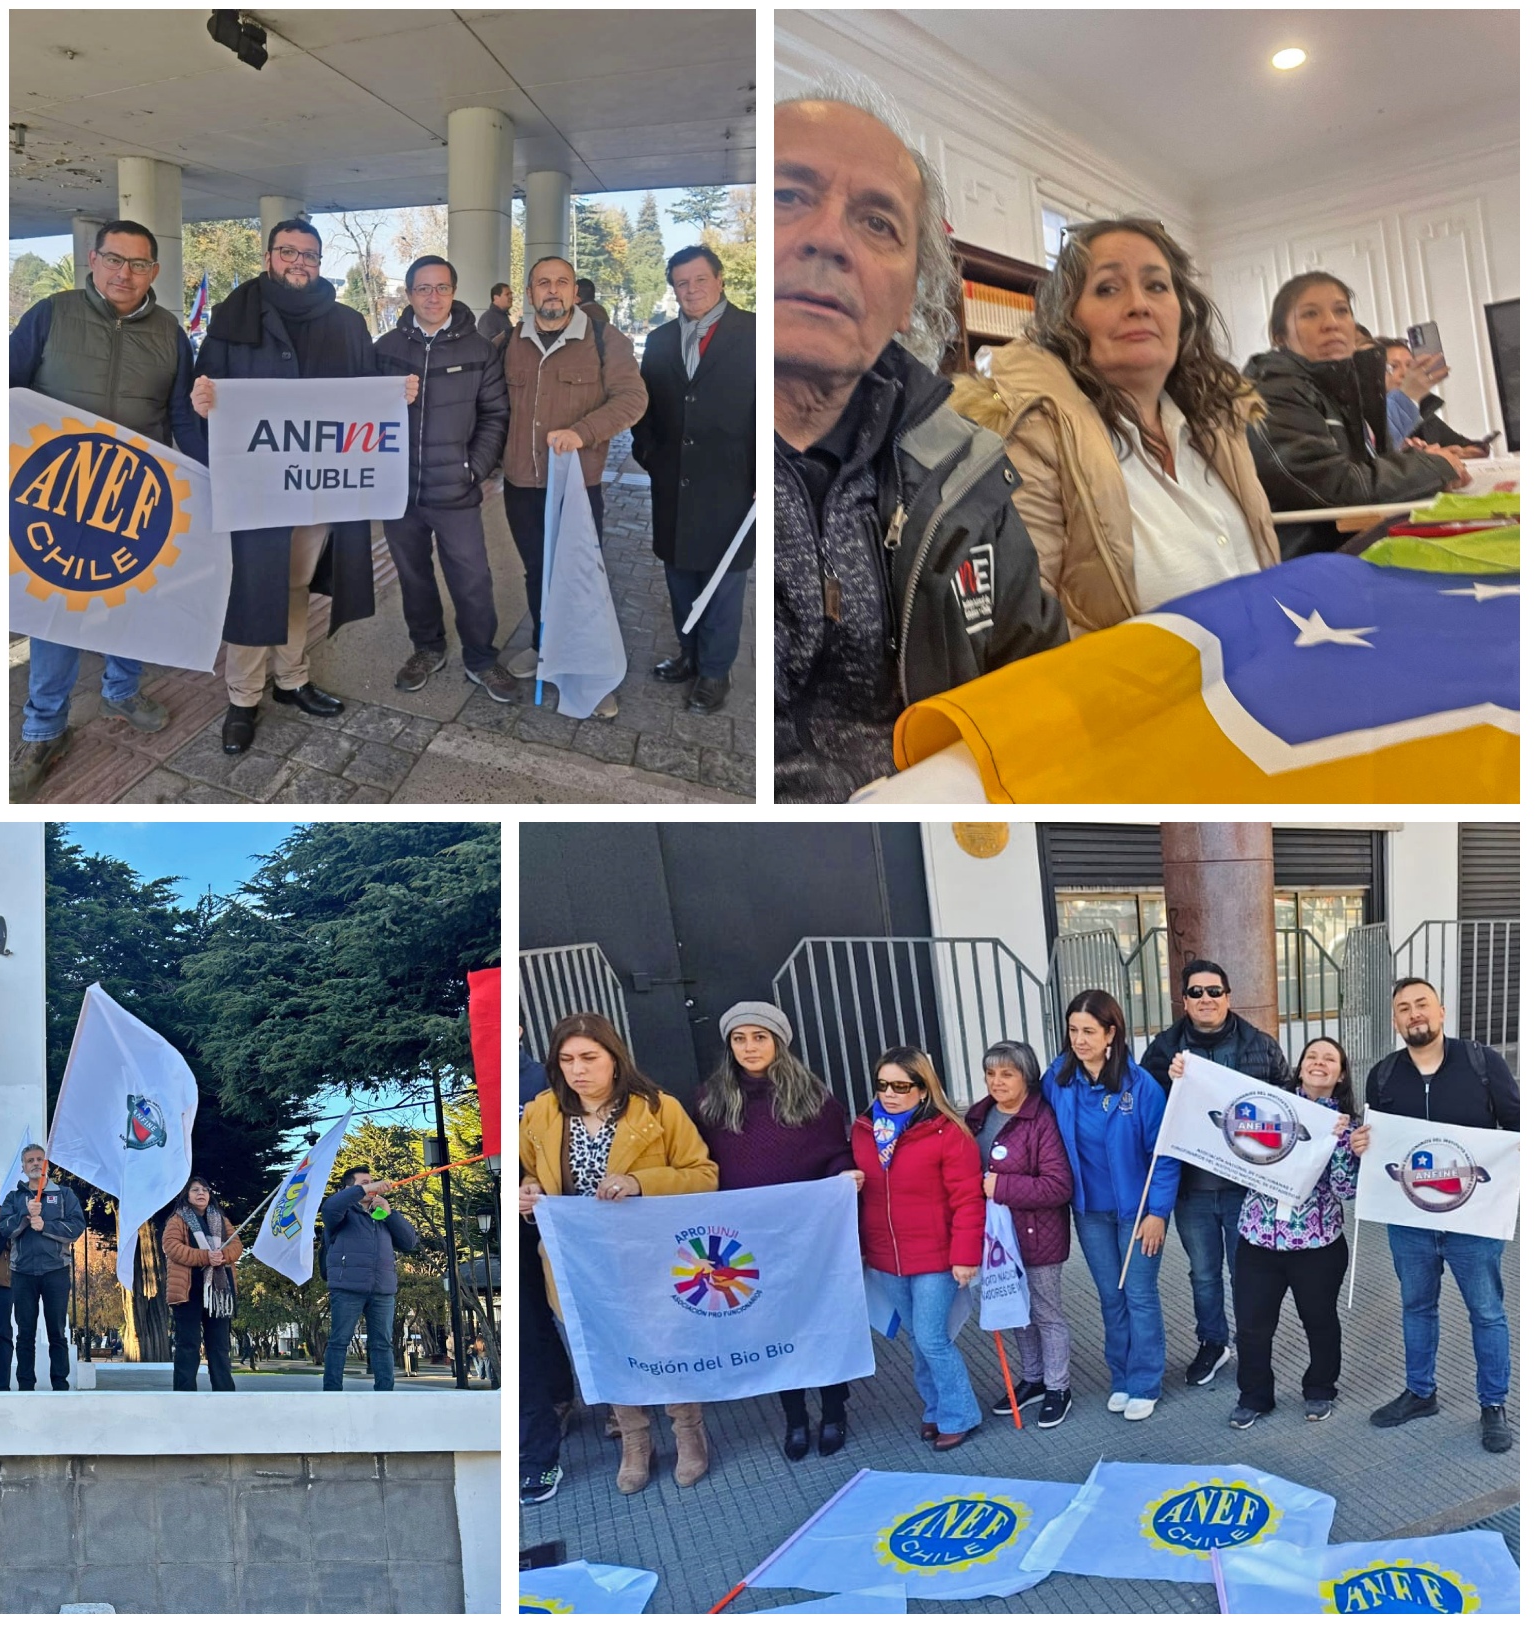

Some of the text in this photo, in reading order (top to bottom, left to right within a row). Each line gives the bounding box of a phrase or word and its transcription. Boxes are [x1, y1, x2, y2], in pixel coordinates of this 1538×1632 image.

[247, 419, 401, 454] ANFINE
[15, 440, 162, 541] ANEF
[284, 464, 375, 491] ÑUBLE
[27, 521, 138, 581] CHILE
[132, 1107, 158, 1134] ANFINE
[1238, 1120, 1282, 1132] ANFINE
[1414, 1169, 1459, 1181] ANFINE
[674, 1225, 740, 1244] APROJUNJI
[670, 1289, 763, 1318] ASOCIACIÓN PRO FUNCIONARIOS
[628, 1342, 795, 1378] Región del Bio Bio
[898, 1499, 1010, 1540] ANEF
[1158, 1485, 1259, 1526] ANEF
[901, 1538, 985, 1565] CHILE
[1167, 1525, 1251, 1550] CHILE
[1344, 1571, 1445, 1614] ANEF
